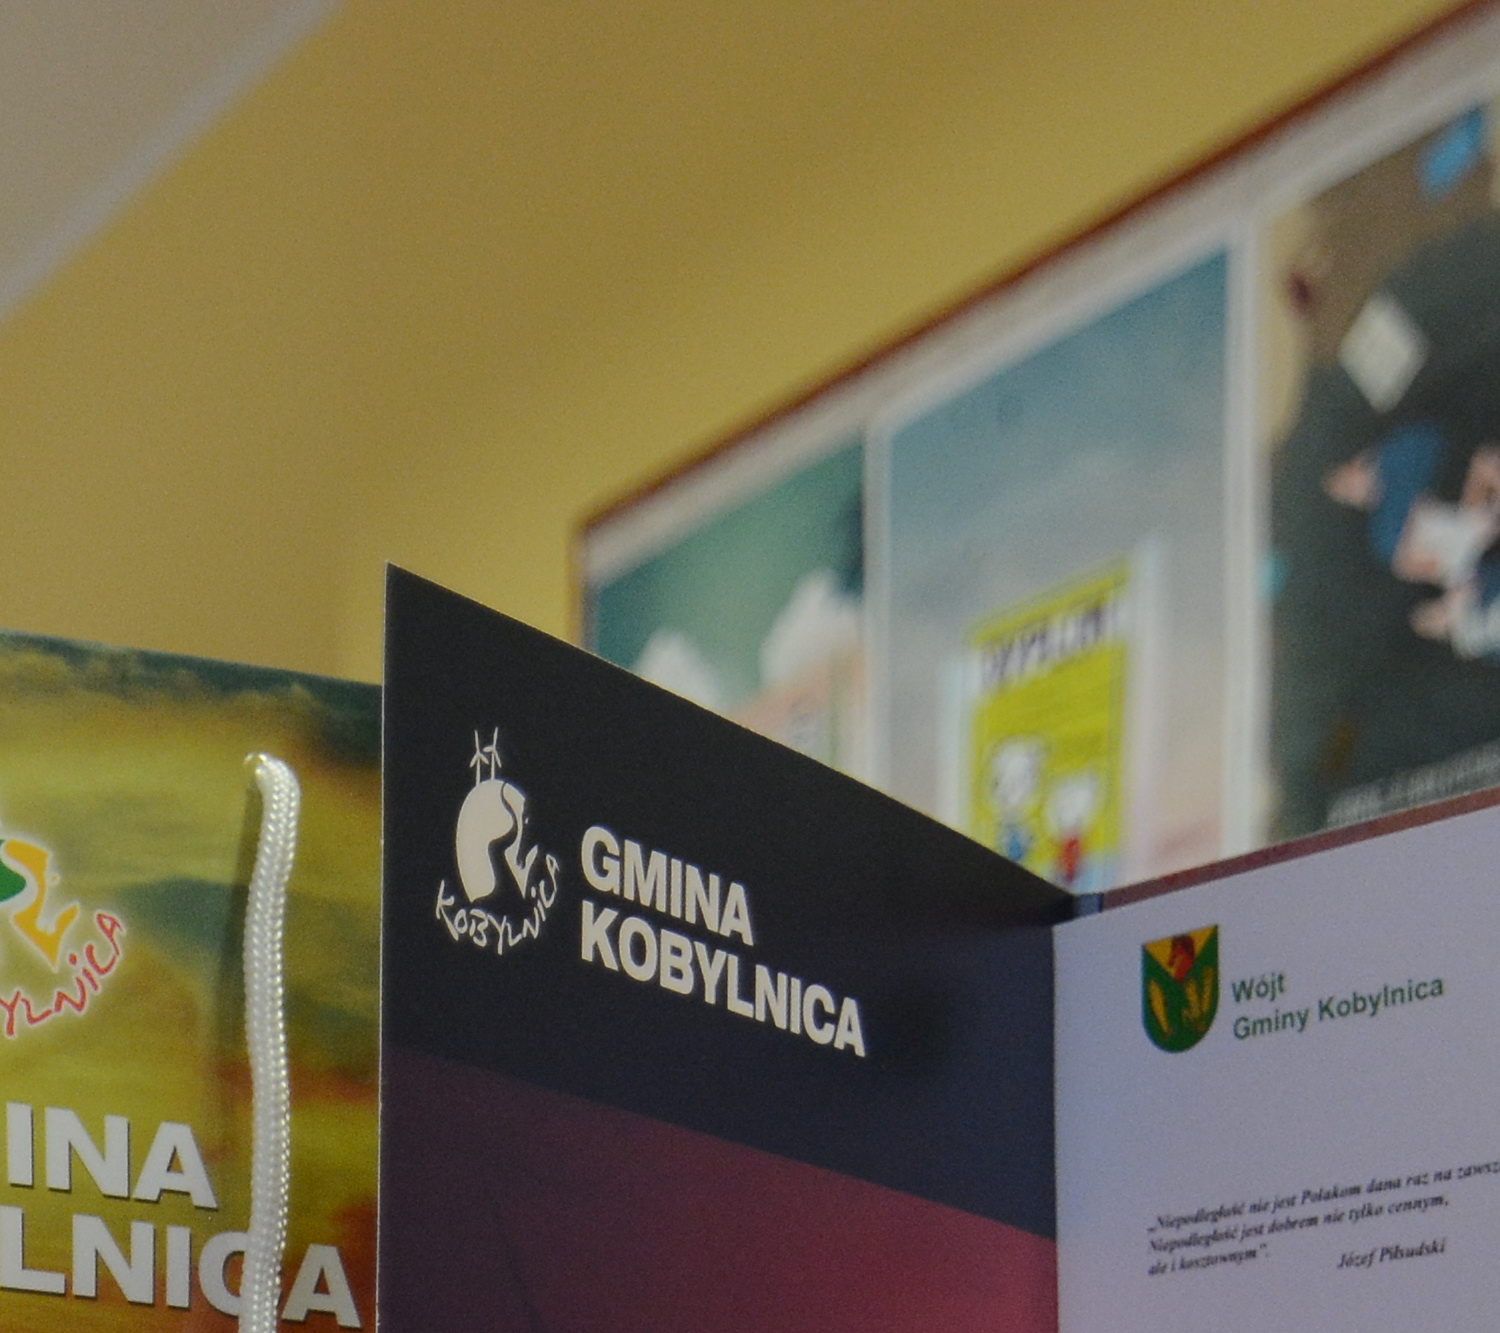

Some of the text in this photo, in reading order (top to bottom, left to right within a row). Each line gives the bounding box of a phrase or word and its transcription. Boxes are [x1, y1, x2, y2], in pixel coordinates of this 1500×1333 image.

[581, 825, 754, 947] GMINA
[580, 900, 867, 1058] KOBYLNICA
[1232, 972, 1287, 1005] Wójt
[1233, 977, 1446, 1042] Gminy Kobylnica
